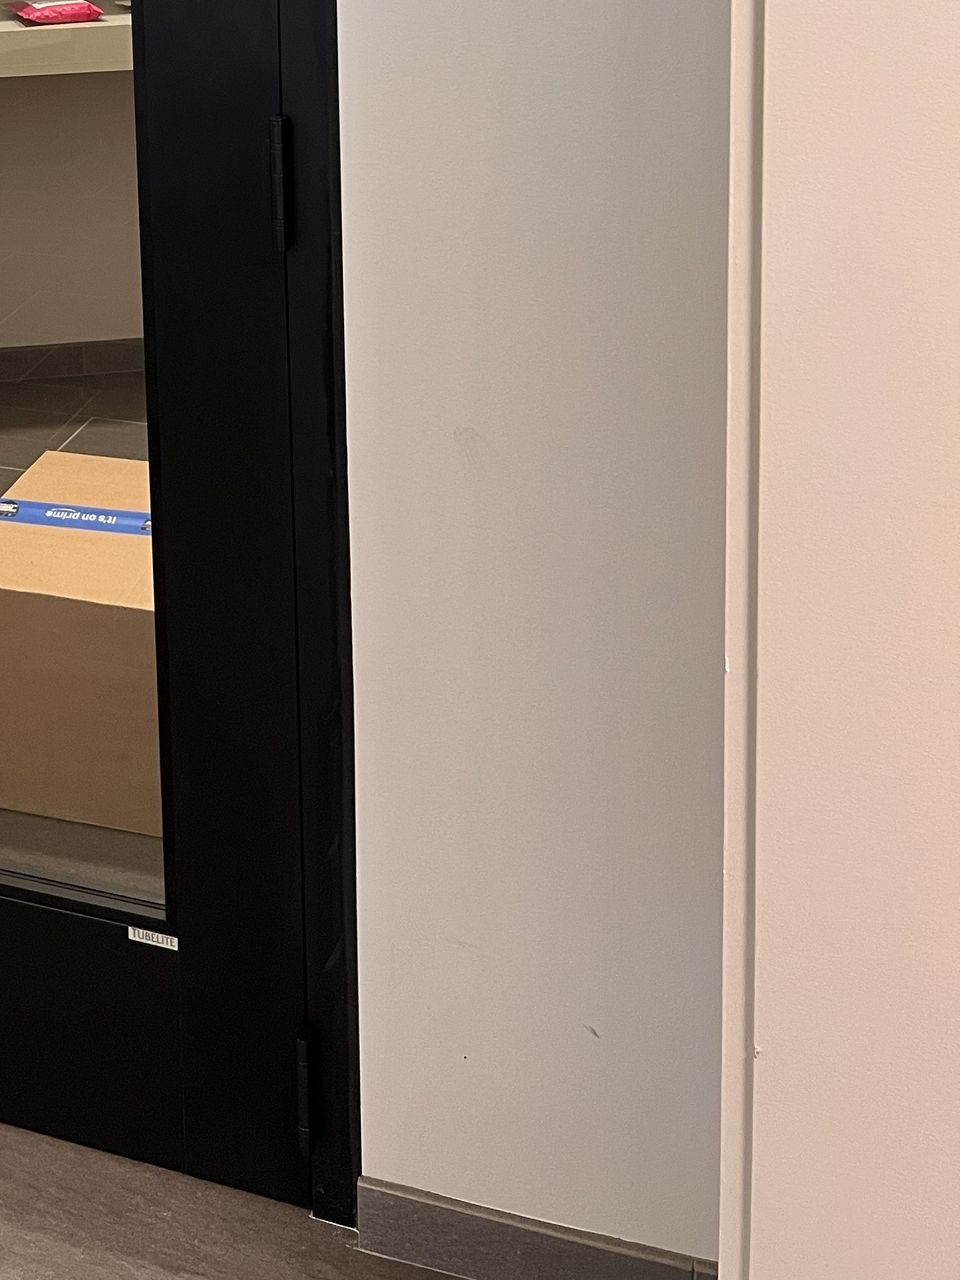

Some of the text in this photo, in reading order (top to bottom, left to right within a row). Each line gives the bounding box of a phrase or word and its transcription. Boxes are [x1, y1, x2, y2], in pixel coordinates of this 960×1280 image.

[44, 509, 81, 521] prime
[81, 512, 97, 521] on
[131, 927, 176, 948] TUBELITE
